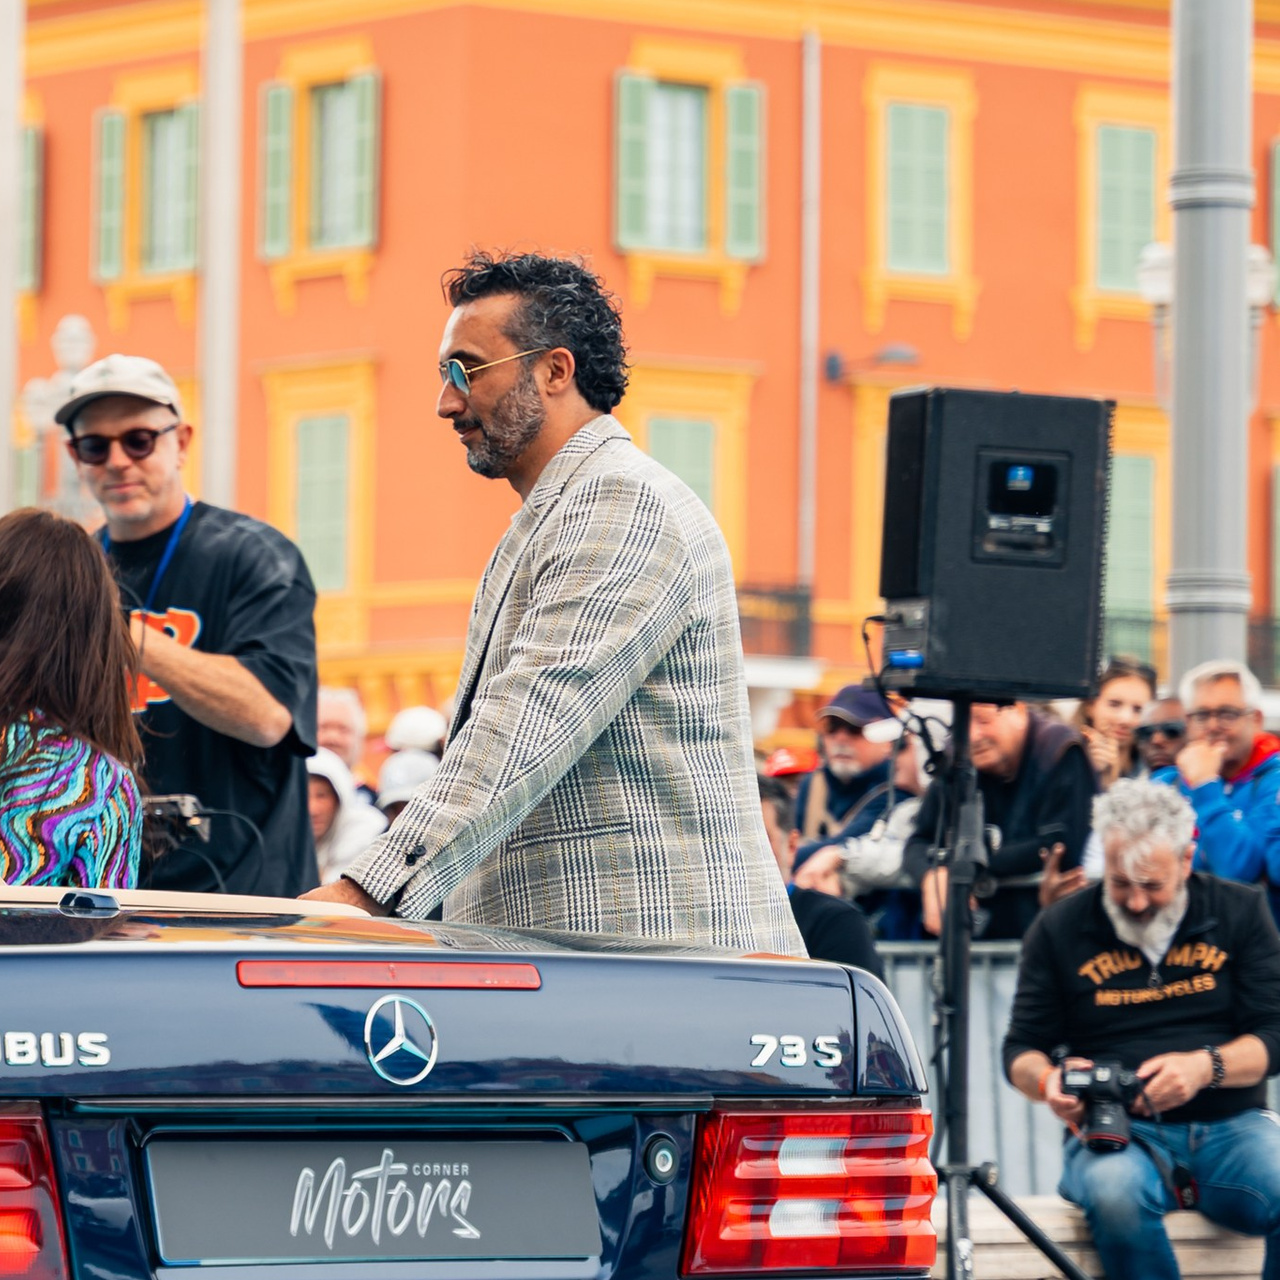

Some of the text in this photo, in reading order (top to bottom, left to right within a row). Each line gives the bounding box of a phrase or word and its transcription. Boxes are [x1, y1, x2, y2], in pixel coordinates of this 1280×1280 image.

[1078, 941, 1229, 986] TRIUMPH
[1094, 972, 1217, 1007] MOTORCYCLES
[412, 1164, 469, 1176] CORNER
[289, 1148, 481, 1250] Motors
